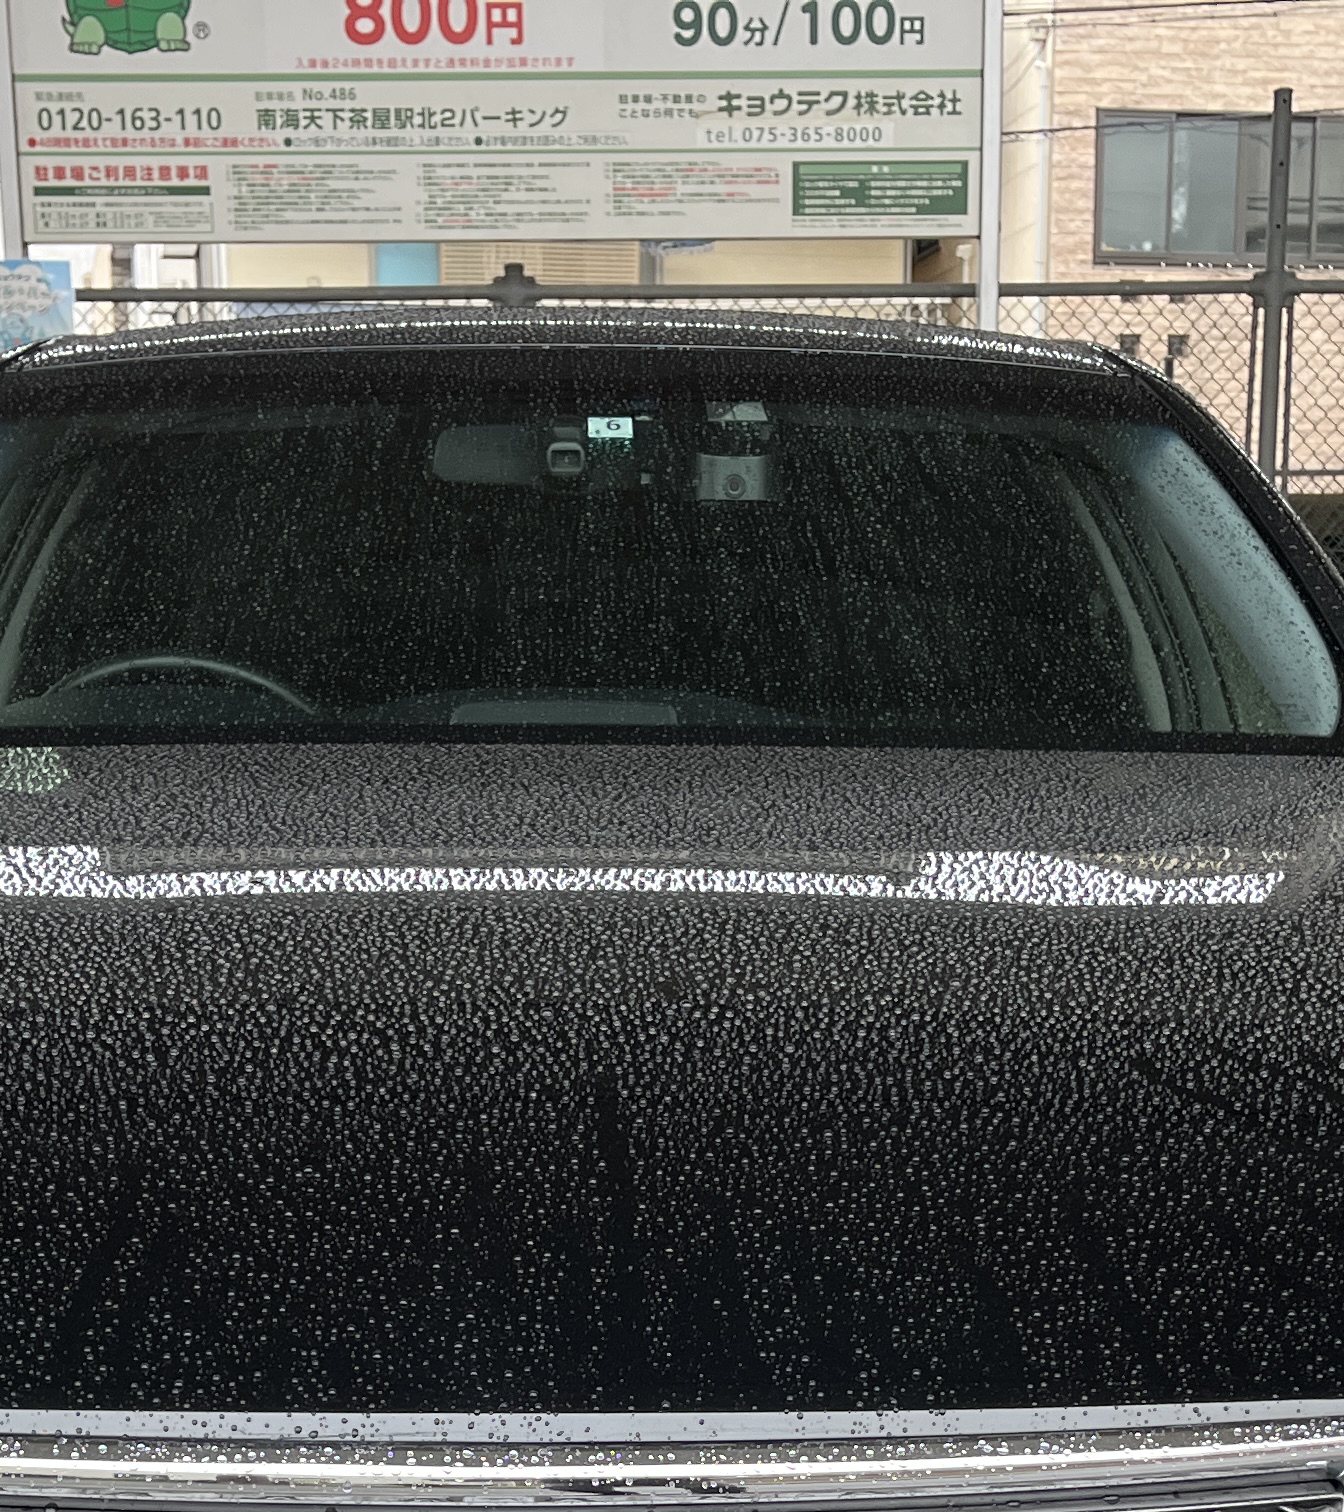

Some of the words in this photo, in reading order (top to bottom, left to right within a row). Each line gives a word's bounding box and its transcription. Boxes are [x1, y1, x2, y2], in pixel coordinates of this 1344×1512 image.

[344, 0, 523, 45] 800円
[673, 0, 925, 46] 90分/100円
[302, 87, 357, 101] No.486
[717, 88, 963, 119] キョウテク株式会社
[37, 107, 222, 131] 0120-163-110
[255, 107, 570, 131] 南海天下茶屋駅北2パーキング
[705, 126, 883, 144] tel.075-365-8000
[34, 164, 209, 182] 駐車場ご利用注意事項
